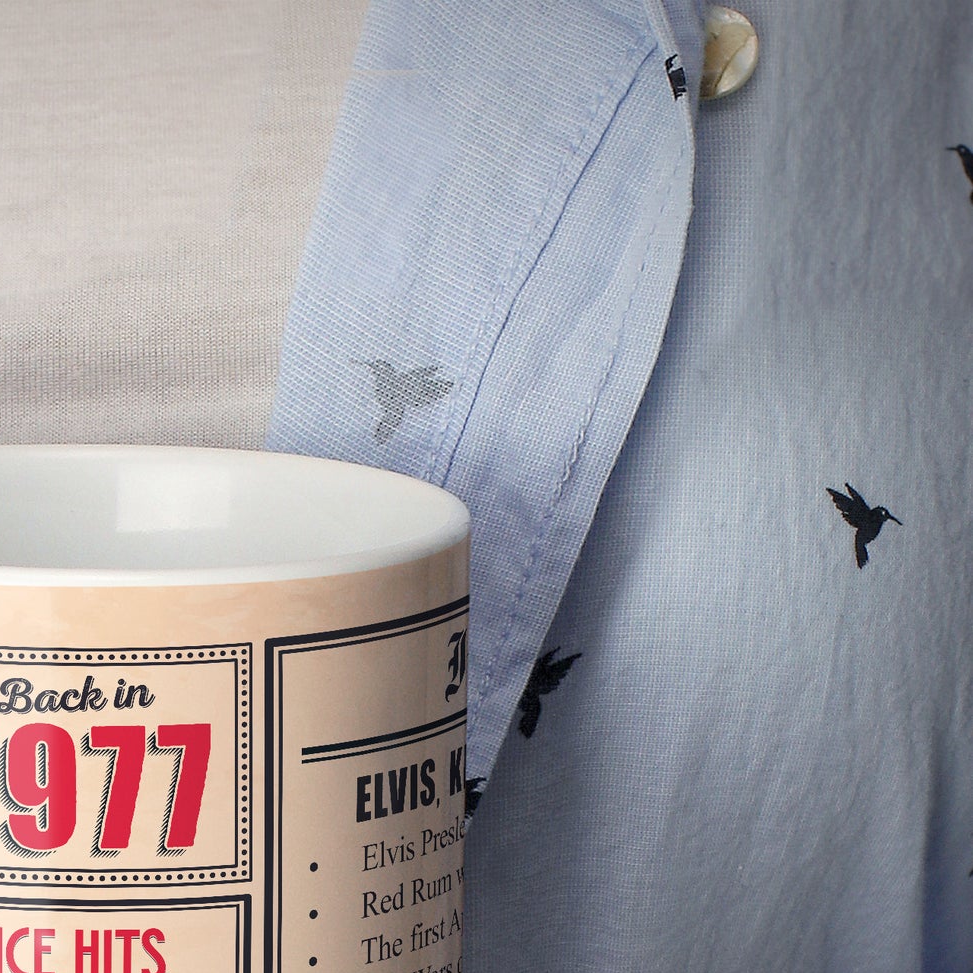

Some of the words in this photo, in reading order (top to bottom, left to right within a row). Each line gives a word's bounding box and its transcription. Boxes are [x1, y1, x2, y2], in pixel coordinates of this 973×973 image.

[113, 677, 156, 710] in
[356, 758, 440, 823] ELVIS,
[361, 836, 415, 872] Elvis
[360, 882, 404, 919] Red
[410, 872, 452, 906] Rum
[360, 934, 403, 965] The
[410, 917, 445, 952] first
